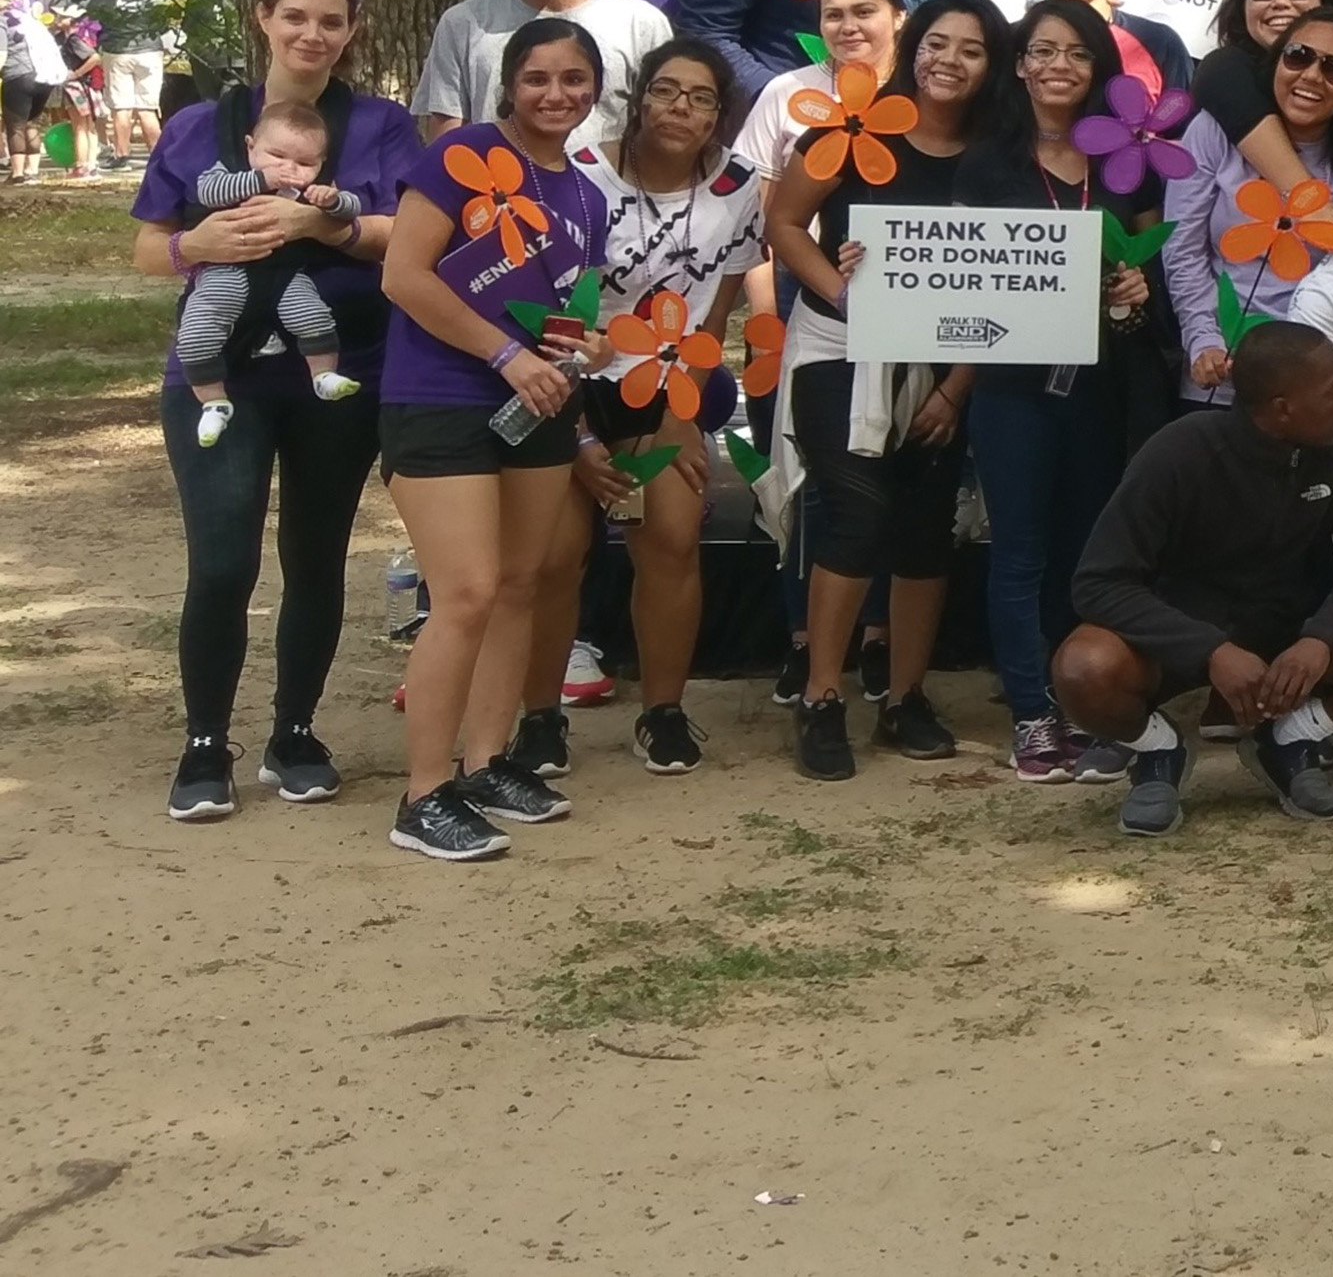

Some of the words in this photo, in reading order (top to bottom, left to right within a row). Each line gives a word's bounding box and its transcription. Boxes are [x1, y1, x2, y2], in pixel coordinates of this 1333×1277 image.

[885, 220, 986, 242] THANK
[1004, 223, 1067, 243] YOU
[469, 234, 554, 294] #ENDLZ
[885, 247, 933, 263] FOR
[943, 248, 1067, 266] DONATING
[884, 272, 919, 289] TO
[928, 273, 982, 290] OUR
[990, 274, 1067, 292] TEAM.
[939, 316, 969, 325] WALK
[971, 316, 985, 326] TO
[938, 327, 985, 337] END
